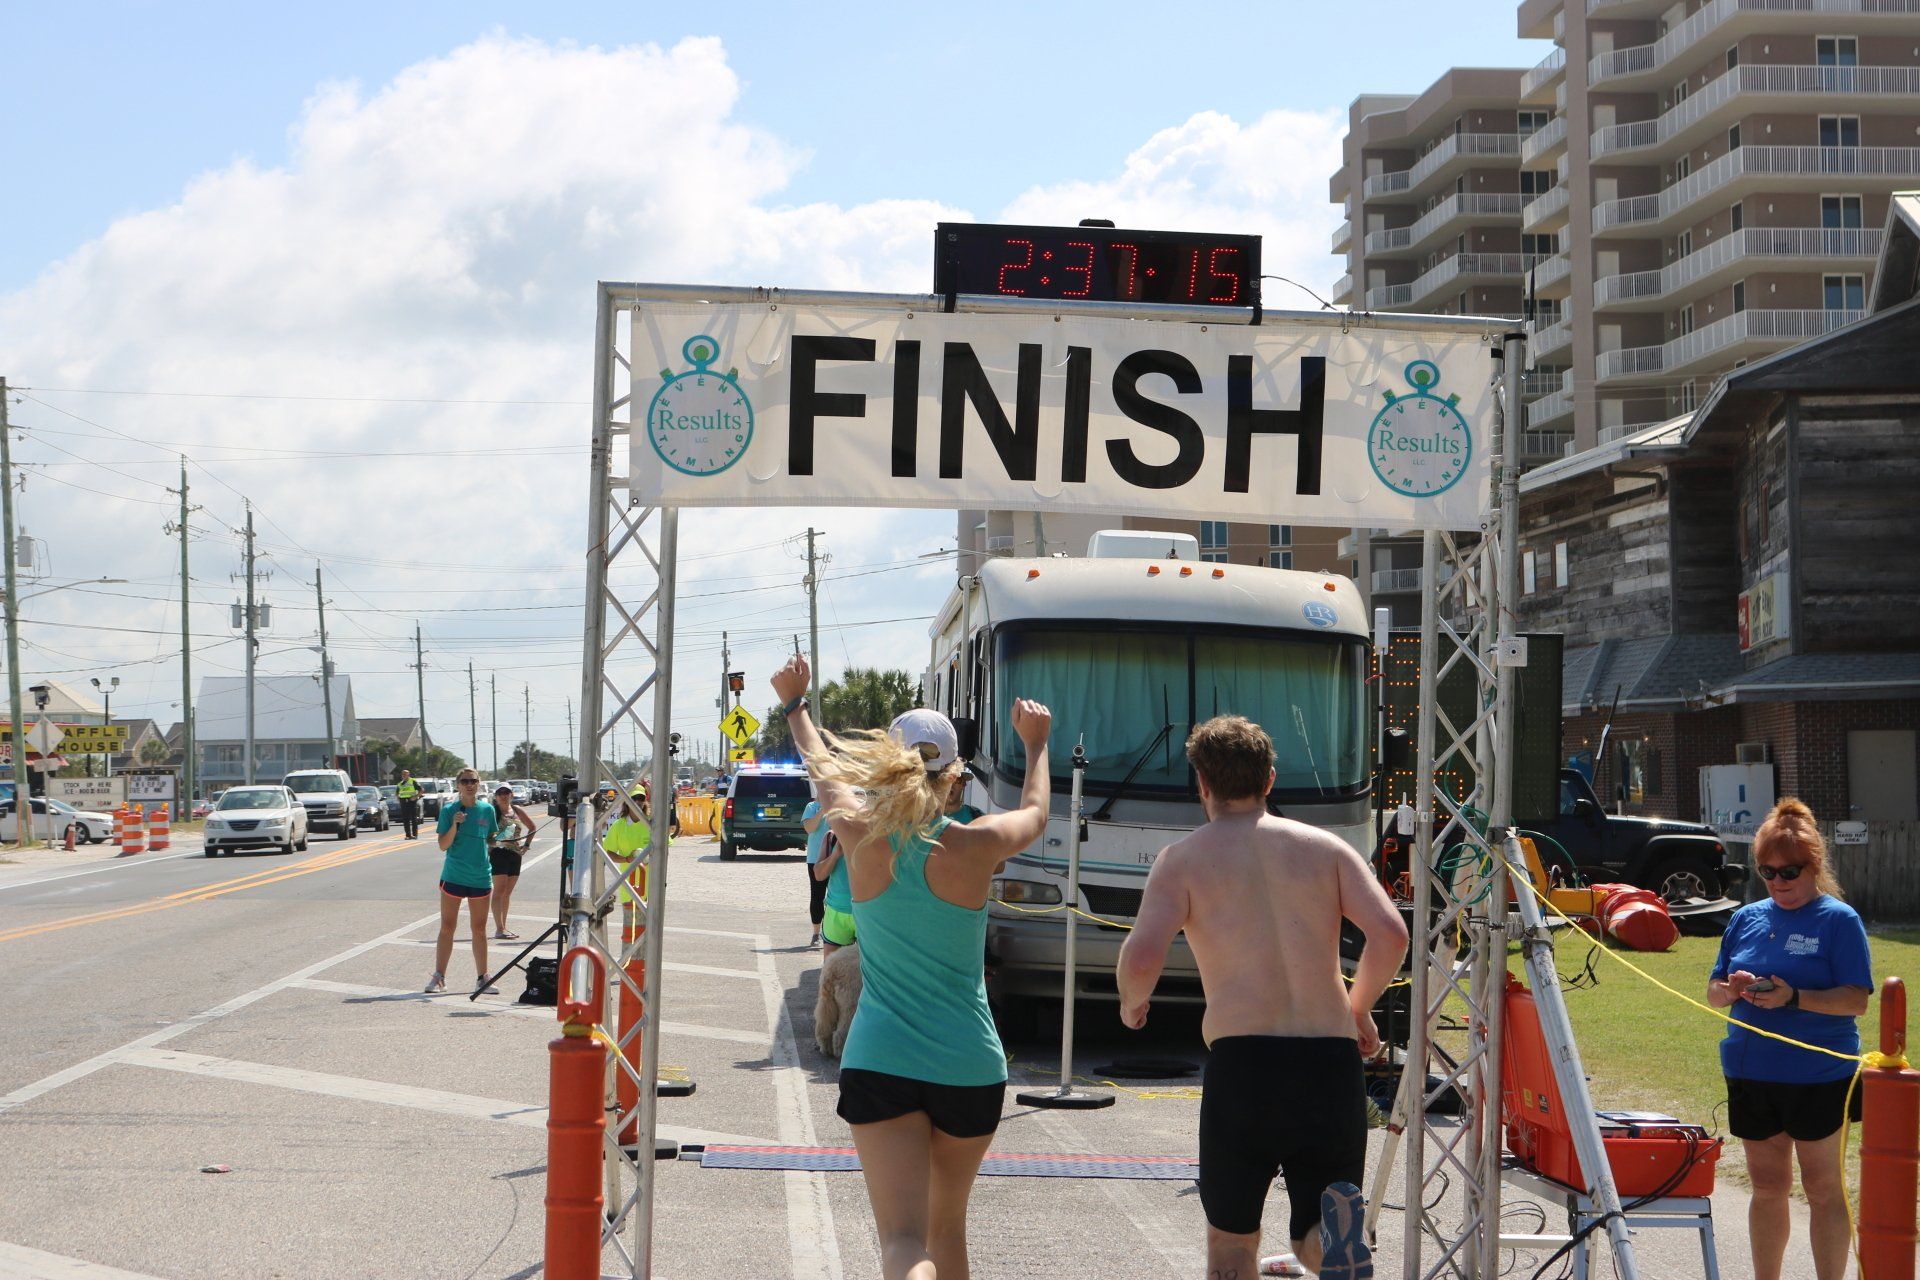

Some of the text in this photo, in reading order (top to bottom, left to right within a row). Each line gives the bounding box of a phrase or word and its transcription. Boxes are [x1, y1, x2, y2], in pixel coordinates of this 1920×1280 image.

[660, 378, 743, 407] EVENT
[658, 409, 742, 431] Results
[788, 335, 1326, 496] FINISH
[1381, 401, 1461, 427] EVENT
[659, 434, 744, 467] TIMING
[1378, 430, 1460, 454] Results
[1379, 455, 1461, 489] TIMING
[64, 728, 126, 737] AFFLE
[57, 741, 119, 752] HOUSE
